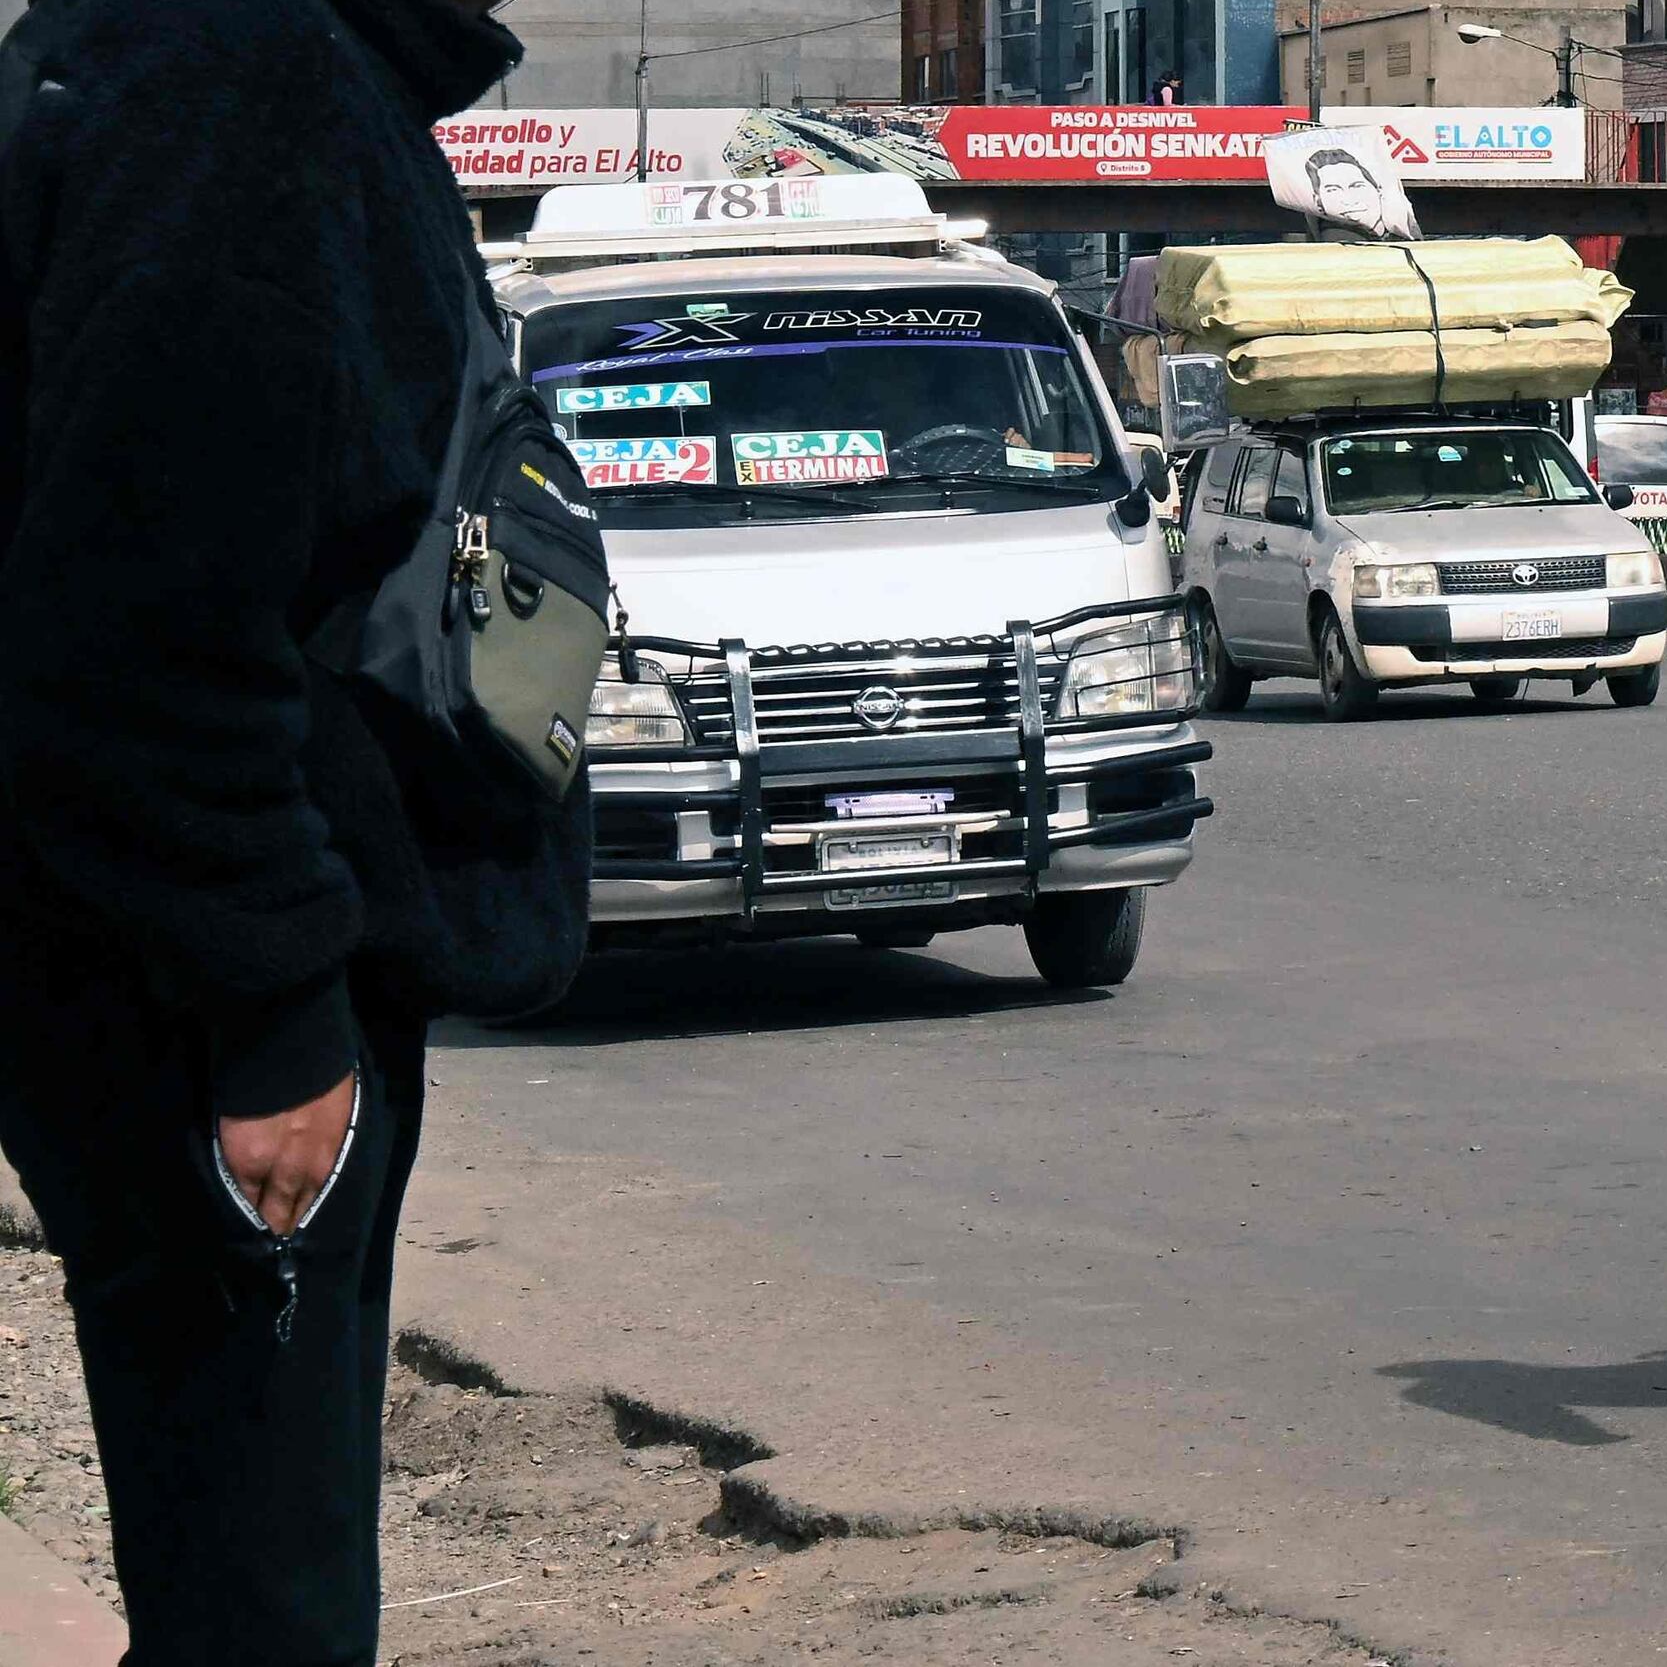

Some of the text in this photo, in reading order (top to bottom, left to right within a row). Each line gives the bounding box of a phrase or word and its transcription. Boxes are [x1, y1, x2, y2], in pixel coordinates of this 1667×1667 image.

[432, 119, 576, 148] esarrollo y
[1051, 112, 1197, 129] PASO A DESNIVEL
[966, 129, 1146, 159] REVOLUCIÓN
[1435, 125, 1552, 148] EL ALTO
[529, 157, 587, 179] para
[595, 149, 620, 173] El
[683, 182, 785, 220] 781
[564, 384, 704, 410] CEJA
[568, 439, 676, 461] CEJA
[736, 433, 881, 459] CEJA
[755, 455, 884, 482] TERMINAL
